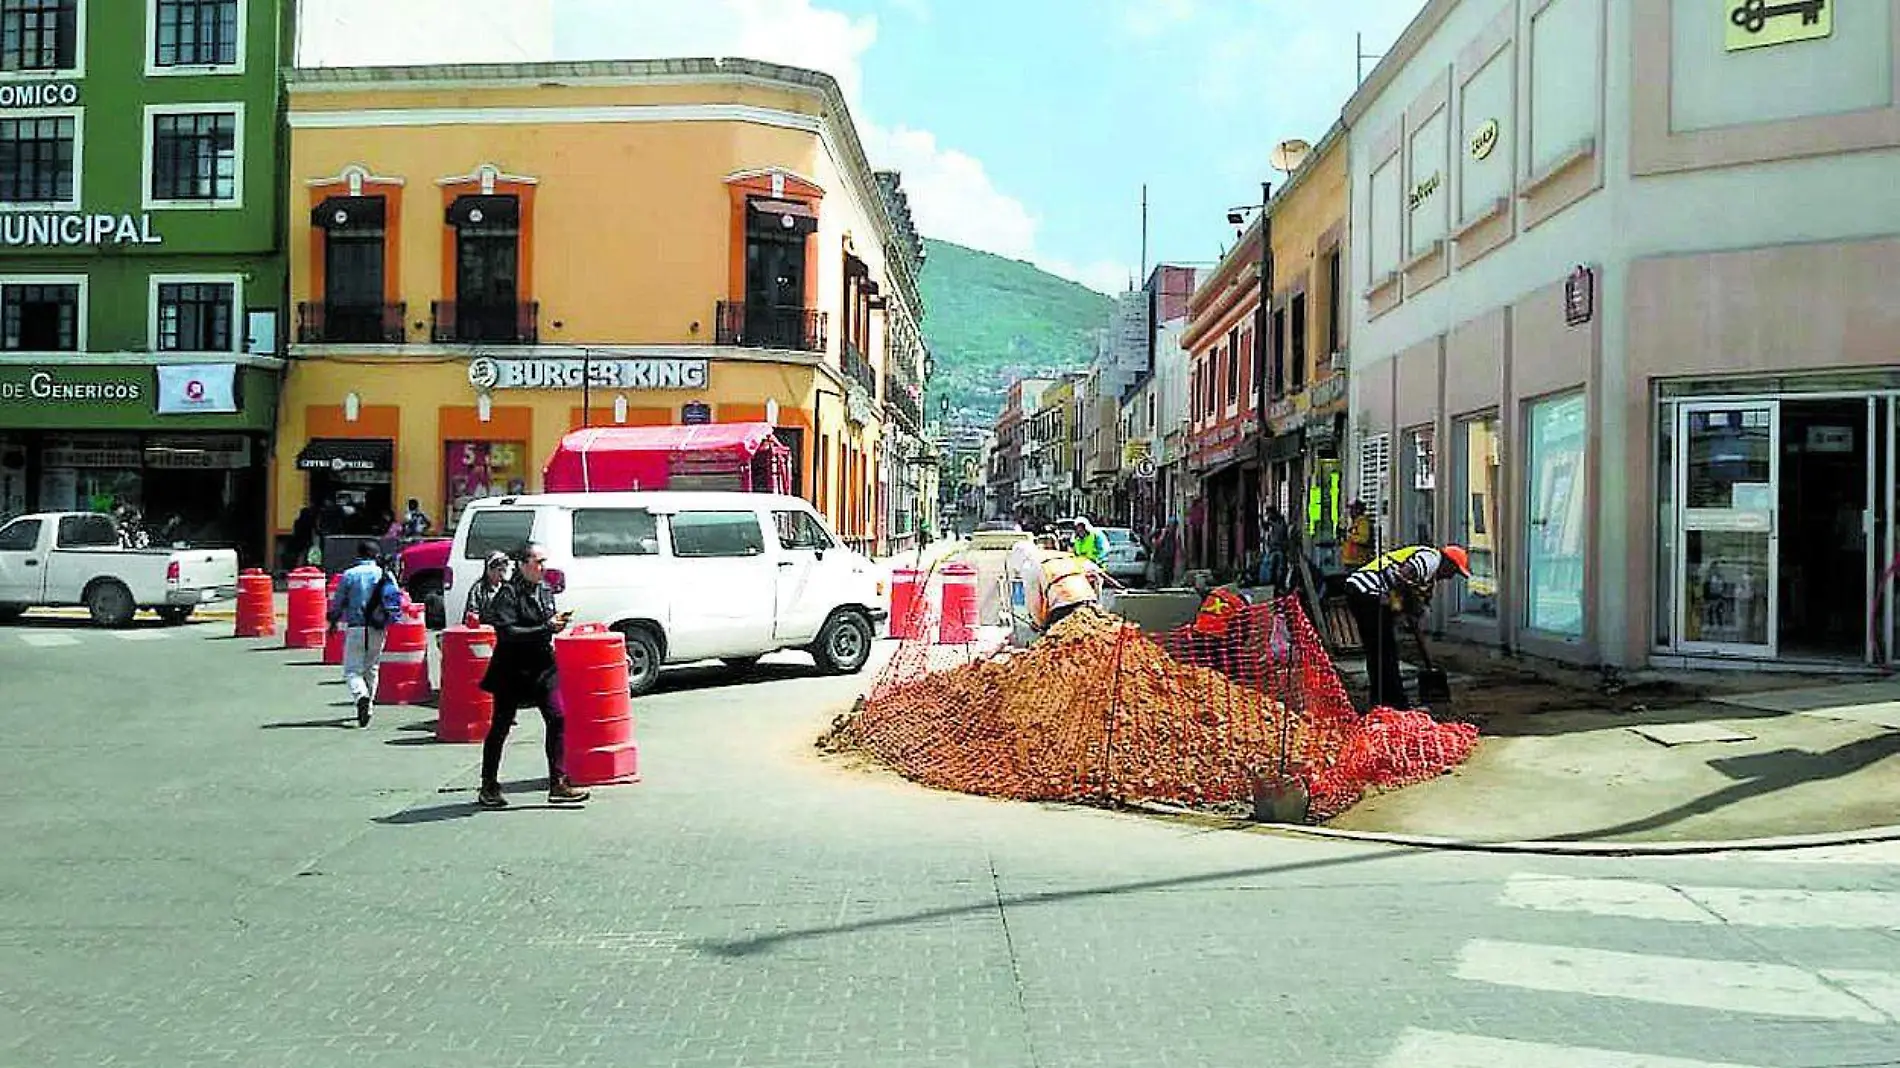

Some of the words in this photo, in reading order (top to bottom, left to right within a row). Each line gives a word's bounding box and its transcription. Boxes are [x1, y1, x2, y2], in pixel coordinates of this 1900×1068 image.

[0, 213, 162, 244] UNICIPAL
[507, 360, 620, 387] BURGER
[627, 360, 706, 387] KING
[2, 382, 25, 397] DE
